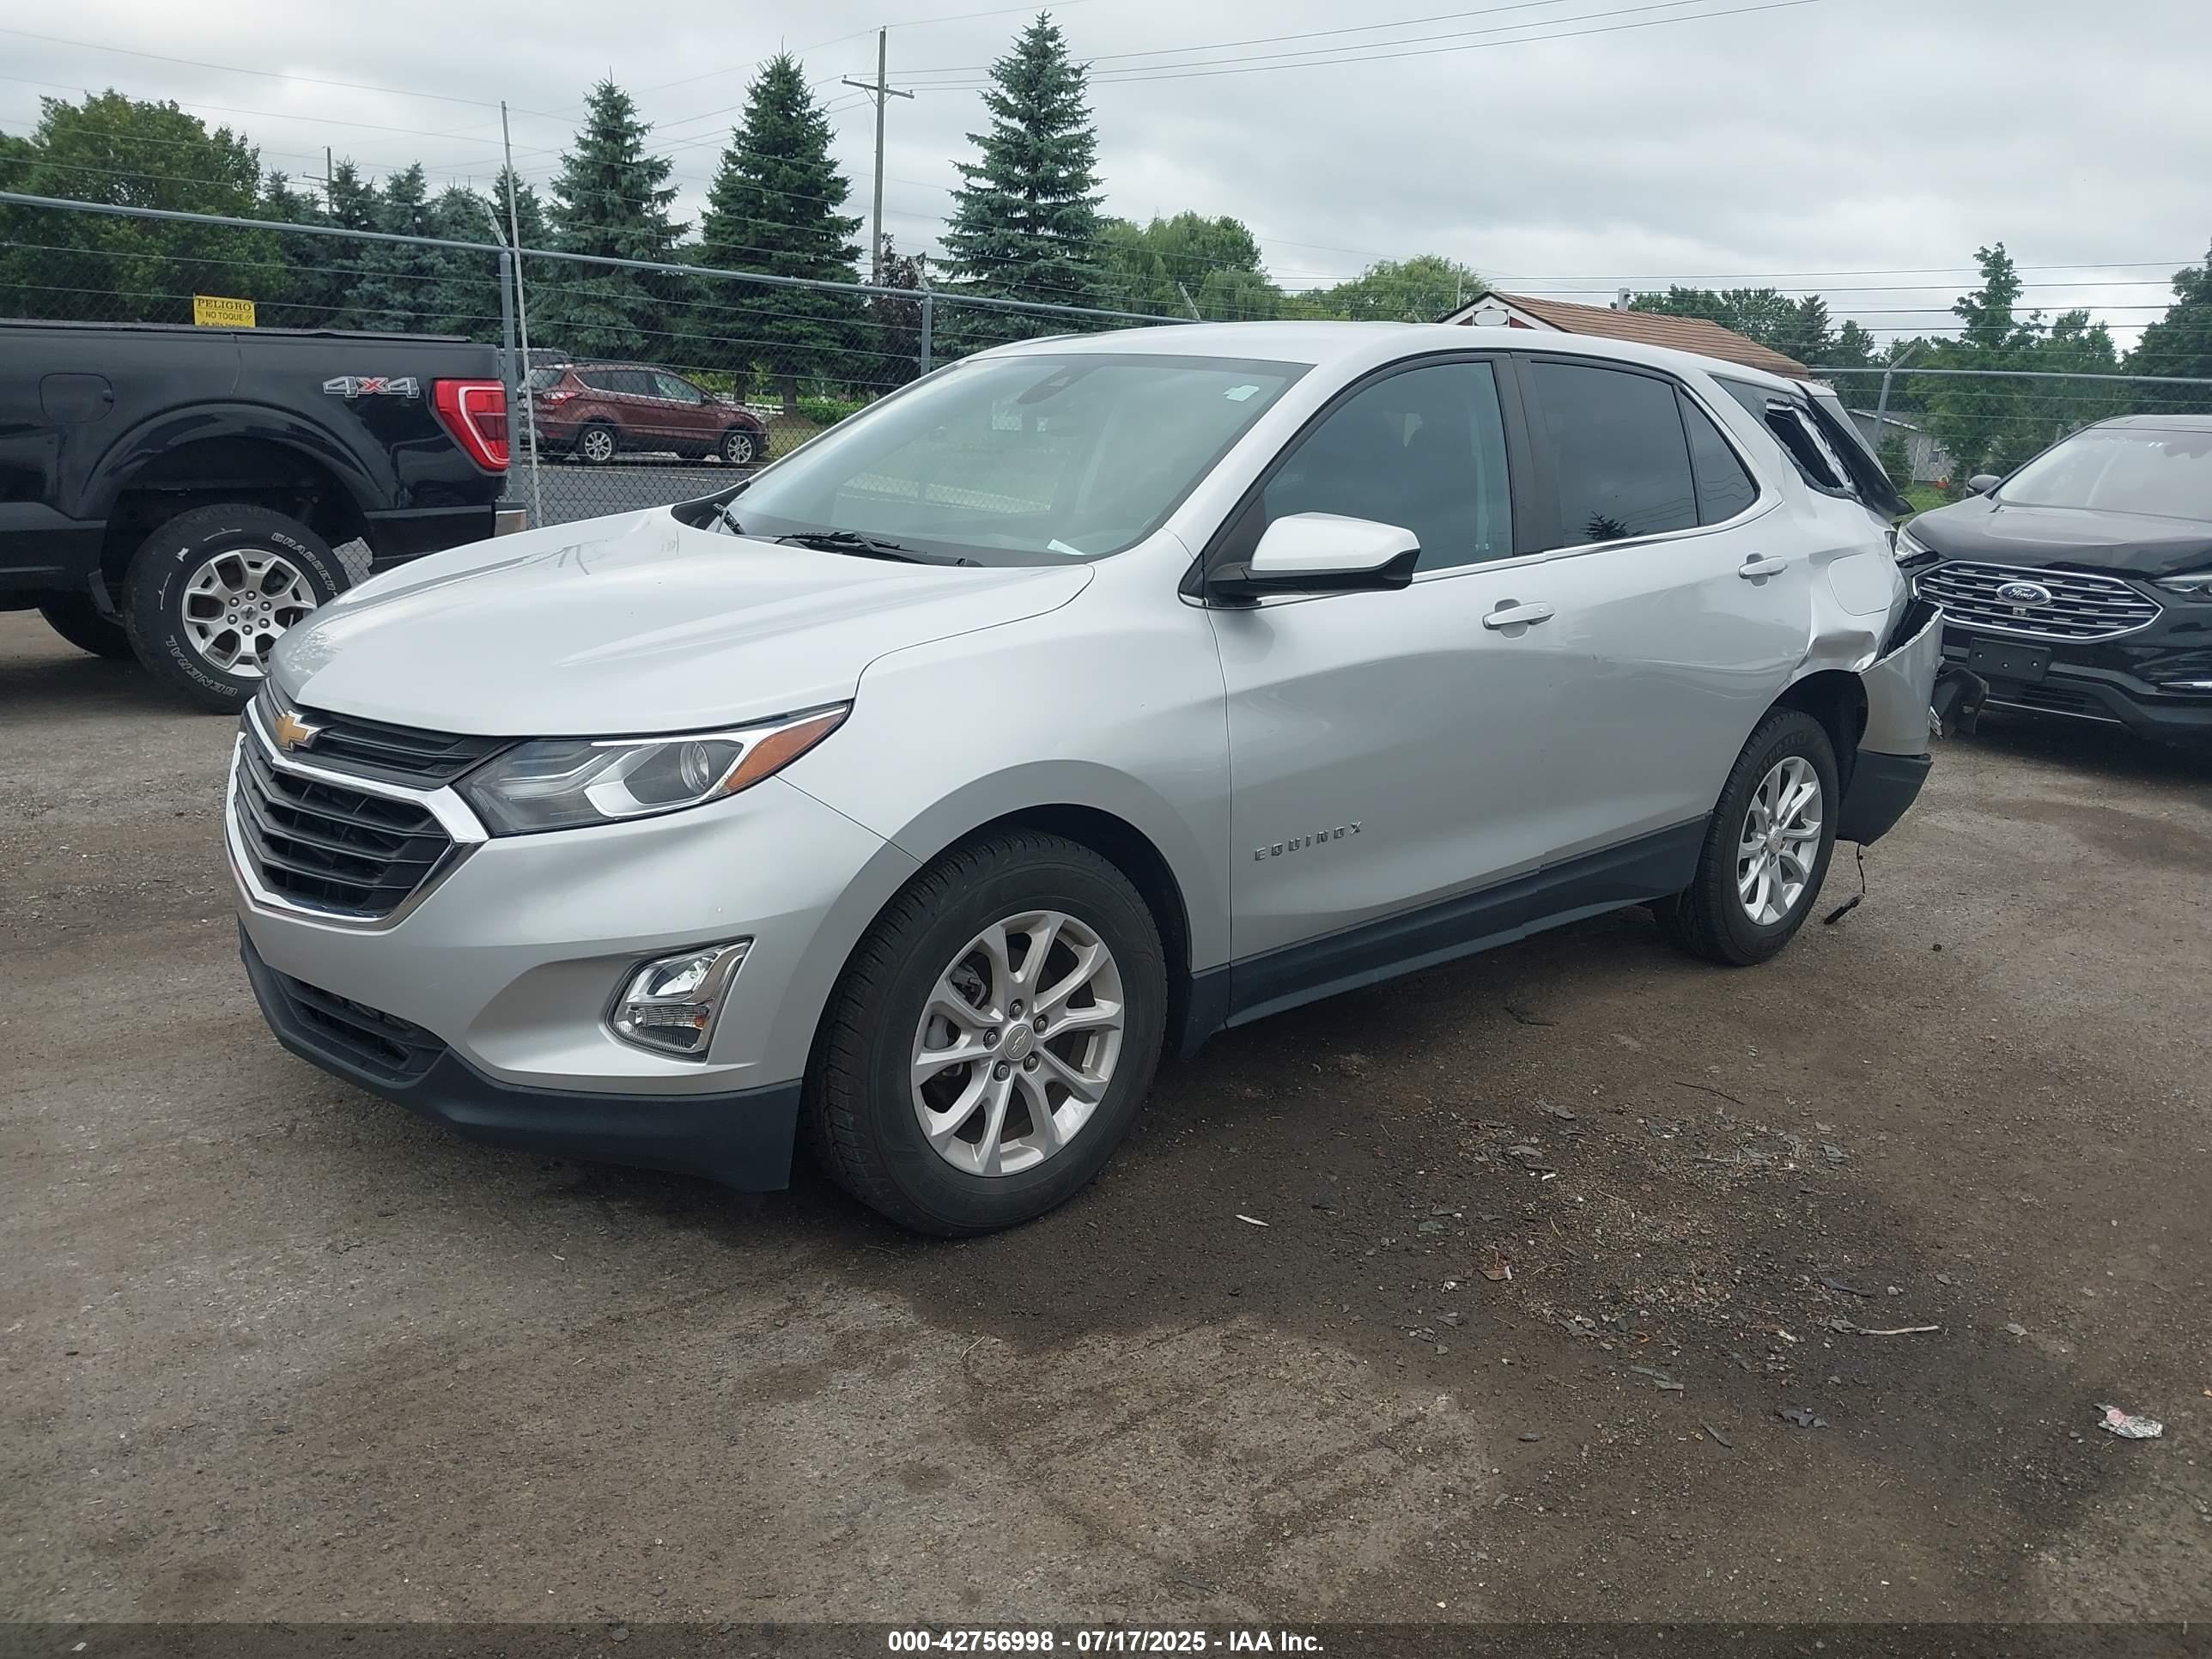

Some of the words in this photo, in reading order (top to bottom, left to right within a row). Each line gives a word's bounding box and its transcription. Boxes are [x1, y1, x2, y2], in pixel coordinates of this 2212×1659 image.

[198, 298, 252, 311] PELIGRO
[218, 312, 244, 321] TOQUE
[270, 532, 336, 591] GRABBER
[2008, 586, 2037, 600] Ford
[166, 635, 238, 696] GENERAL
[1255, 821, 1362, 860] EQUINOX
